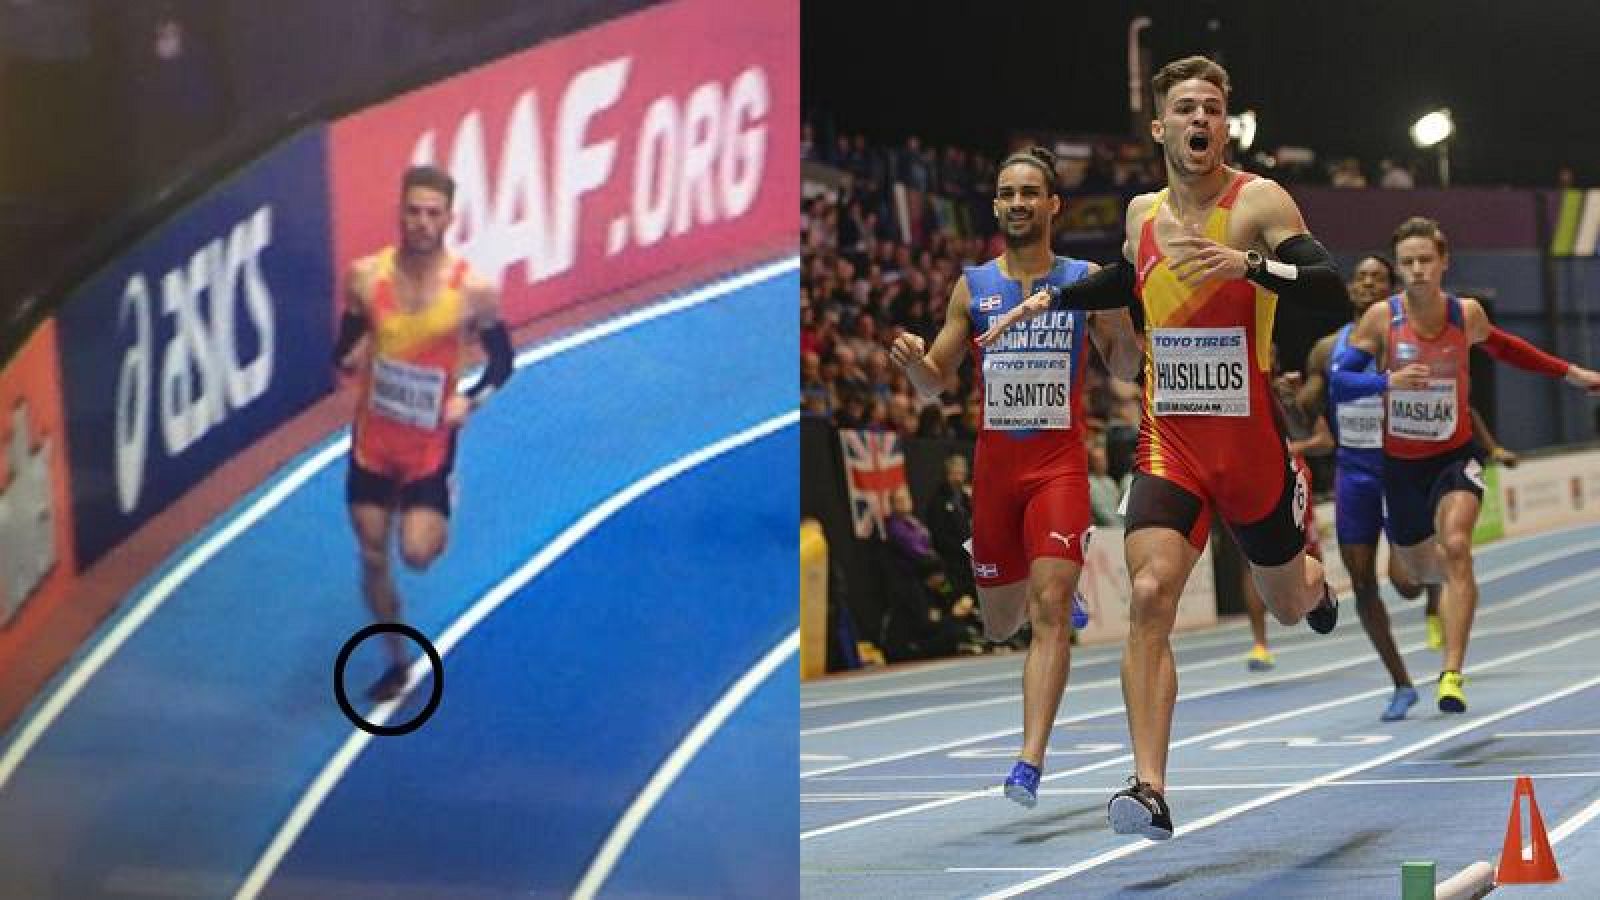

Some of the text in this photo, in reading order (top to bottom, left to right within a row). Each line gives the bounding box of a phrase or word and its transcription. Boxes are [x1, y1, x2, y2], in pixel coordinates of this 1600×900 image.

[412, 57, 768, 292] AAF.ORG
[987, 312, 1073, 329] RBLICA
[986, 331, 1073, 351] MINICANA
[1154, 335, 1241, 347] TOYO TIRES
[1157, 362, 1243, 391] HUSILLOS
[988, 384, 1065, 407] L. SANTOS
